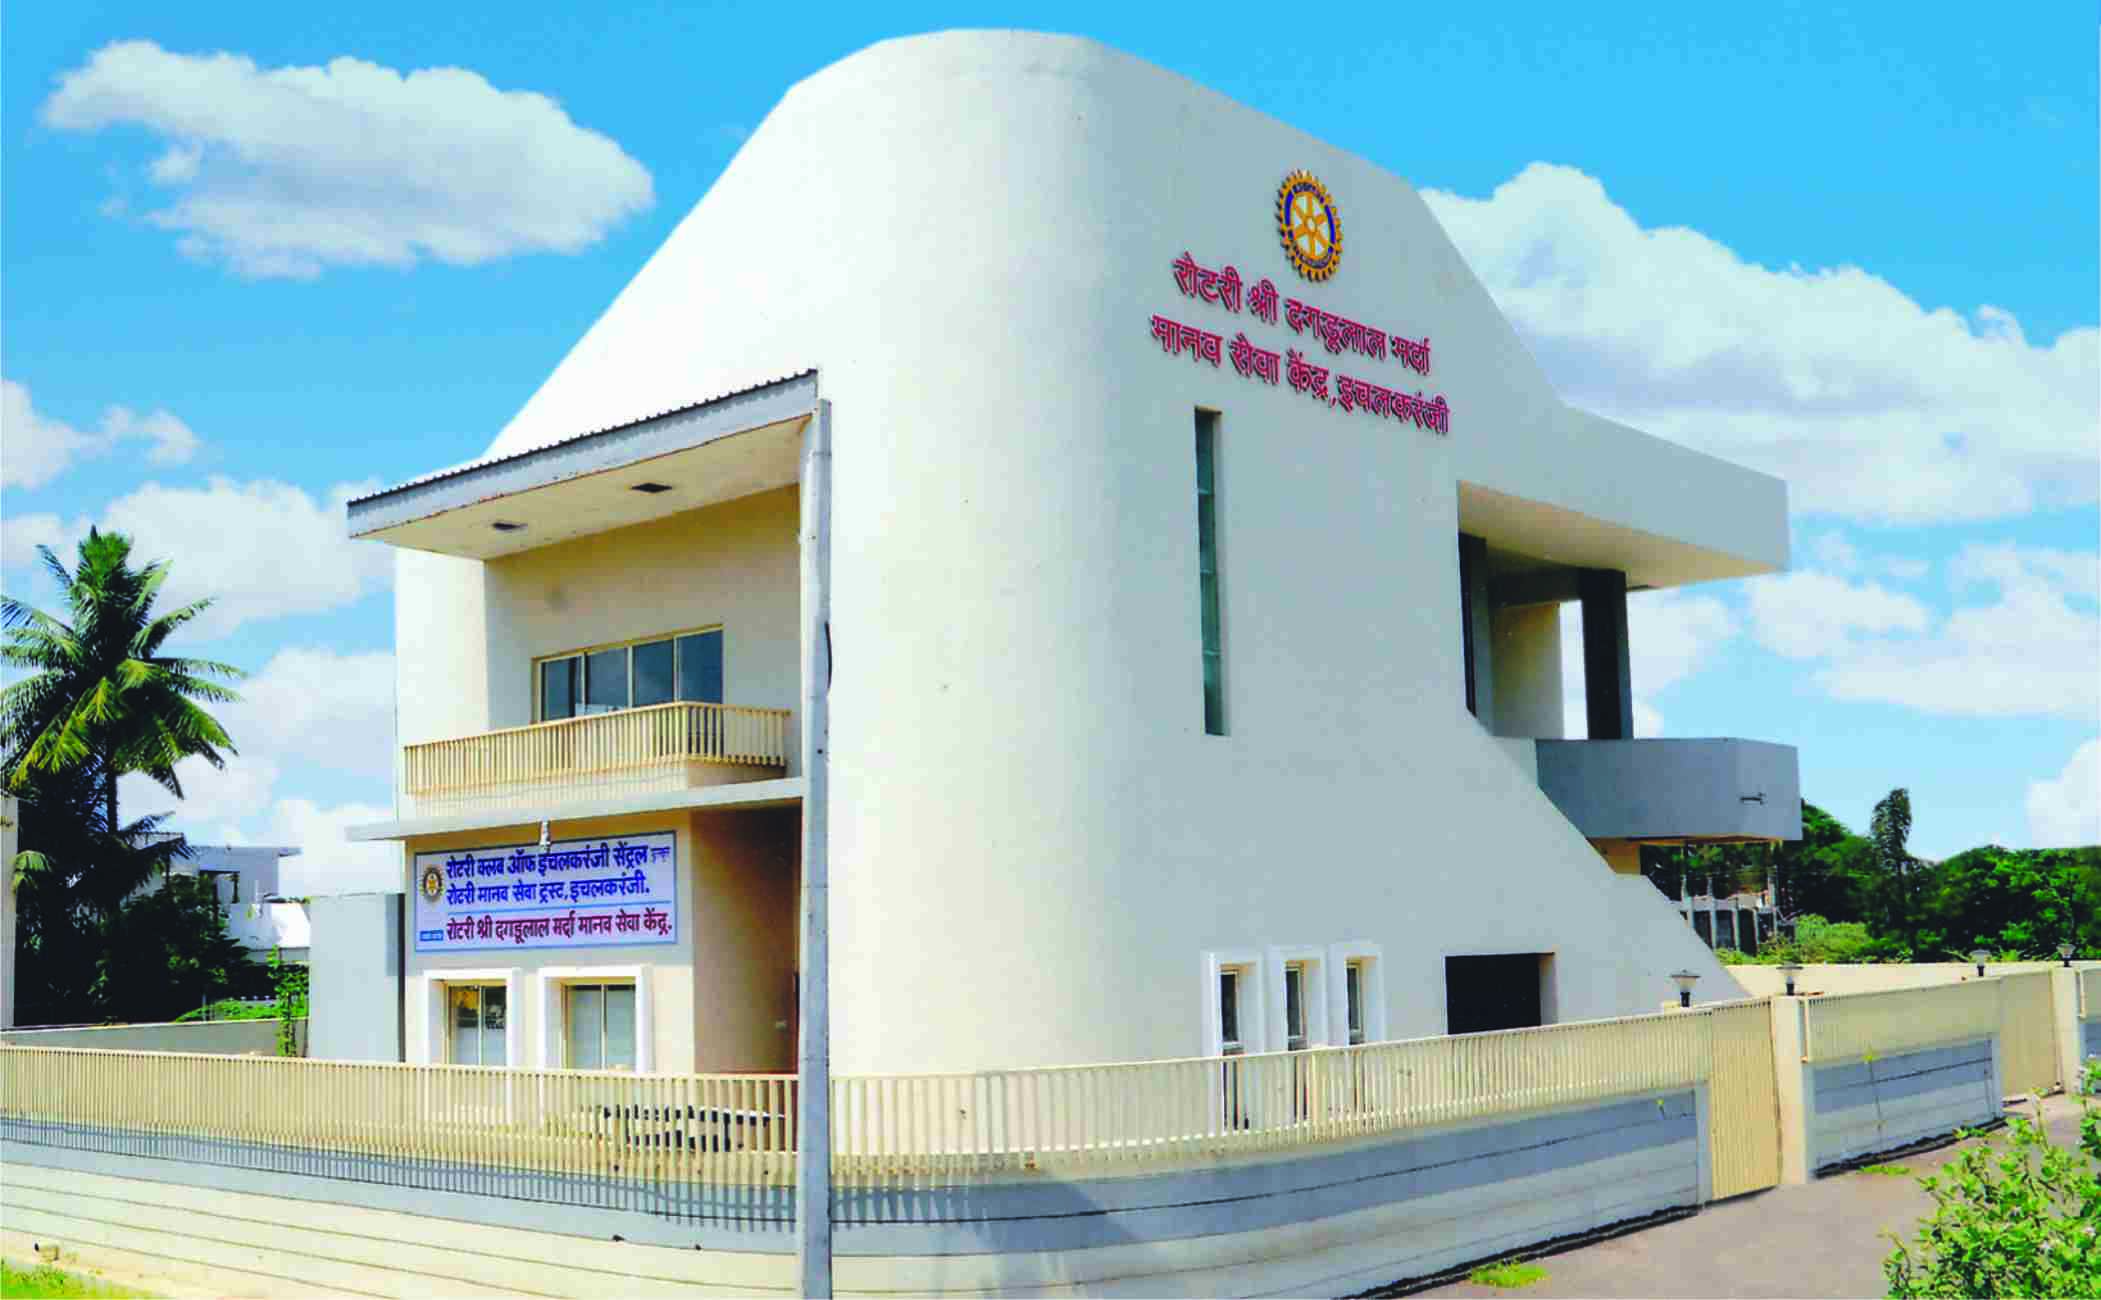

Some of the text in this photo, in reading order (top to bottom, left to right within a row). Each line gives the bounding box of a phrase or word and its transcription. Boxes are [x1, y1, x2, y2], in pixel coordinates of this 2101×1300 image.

[1173, 251, 1242, 313] रोटरी
[1247, 279, 1279, 323] श्री
[1151, 314, 1223, 366] मानव
[1230, 332, 1280, 384] सेवा
[447, 854, 475, 878] रोटरी
[446, 880, 475, 905] रोटरी
[478, 886, 509, 903] मानव
[512, 879, 537, 902] सेवा
[447, 915, 475, 940] रोटरी
[477, 915, 493, 939] श्री
[578, 915, 612, 935] मानव
[615, 908, 640, 932] सेवा
